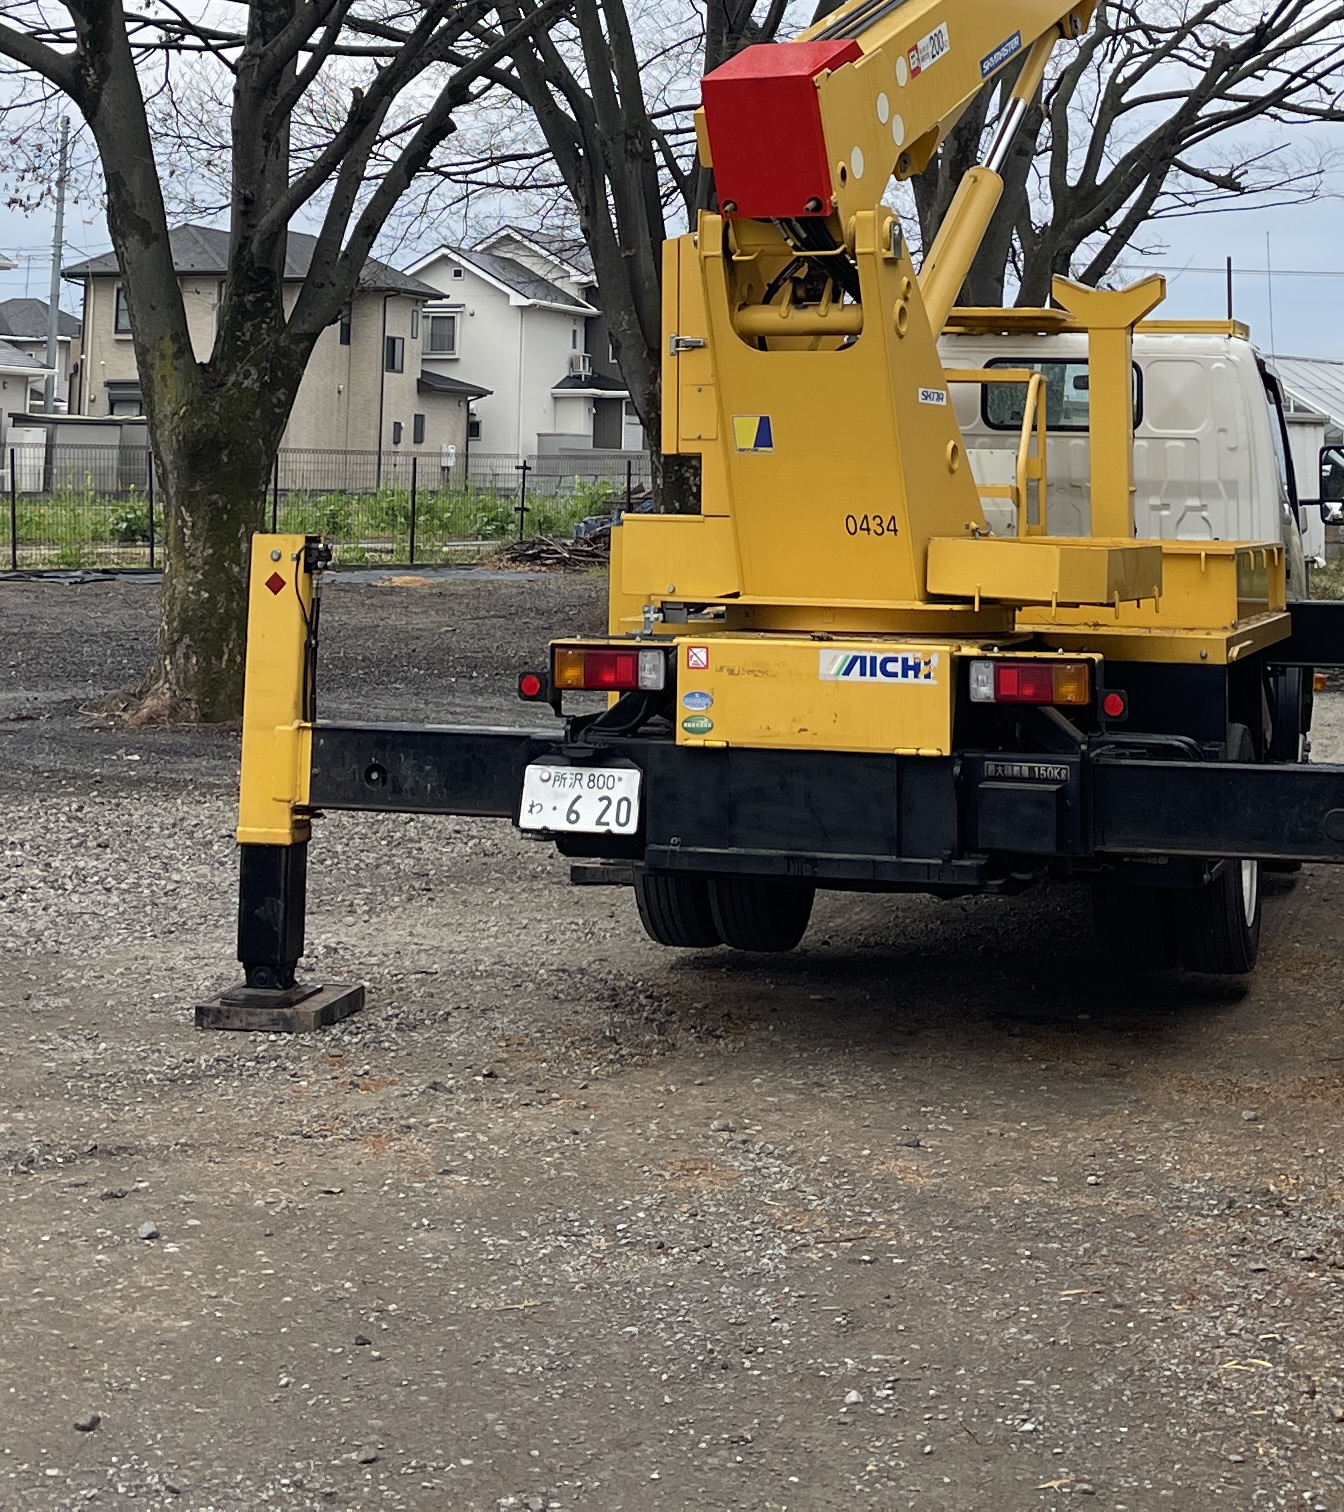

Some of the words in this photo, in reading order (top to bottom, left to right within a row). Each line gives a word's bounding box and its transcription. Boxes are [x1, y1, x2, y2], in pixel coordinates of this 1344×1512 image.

[929, 29, 944, 59] 200
[845, 514, 899, 536] 0434
[552, 771, 584, 789] 所沢
[587, 773, 615, 791] 800
[527, 800, 543, 815] わ
